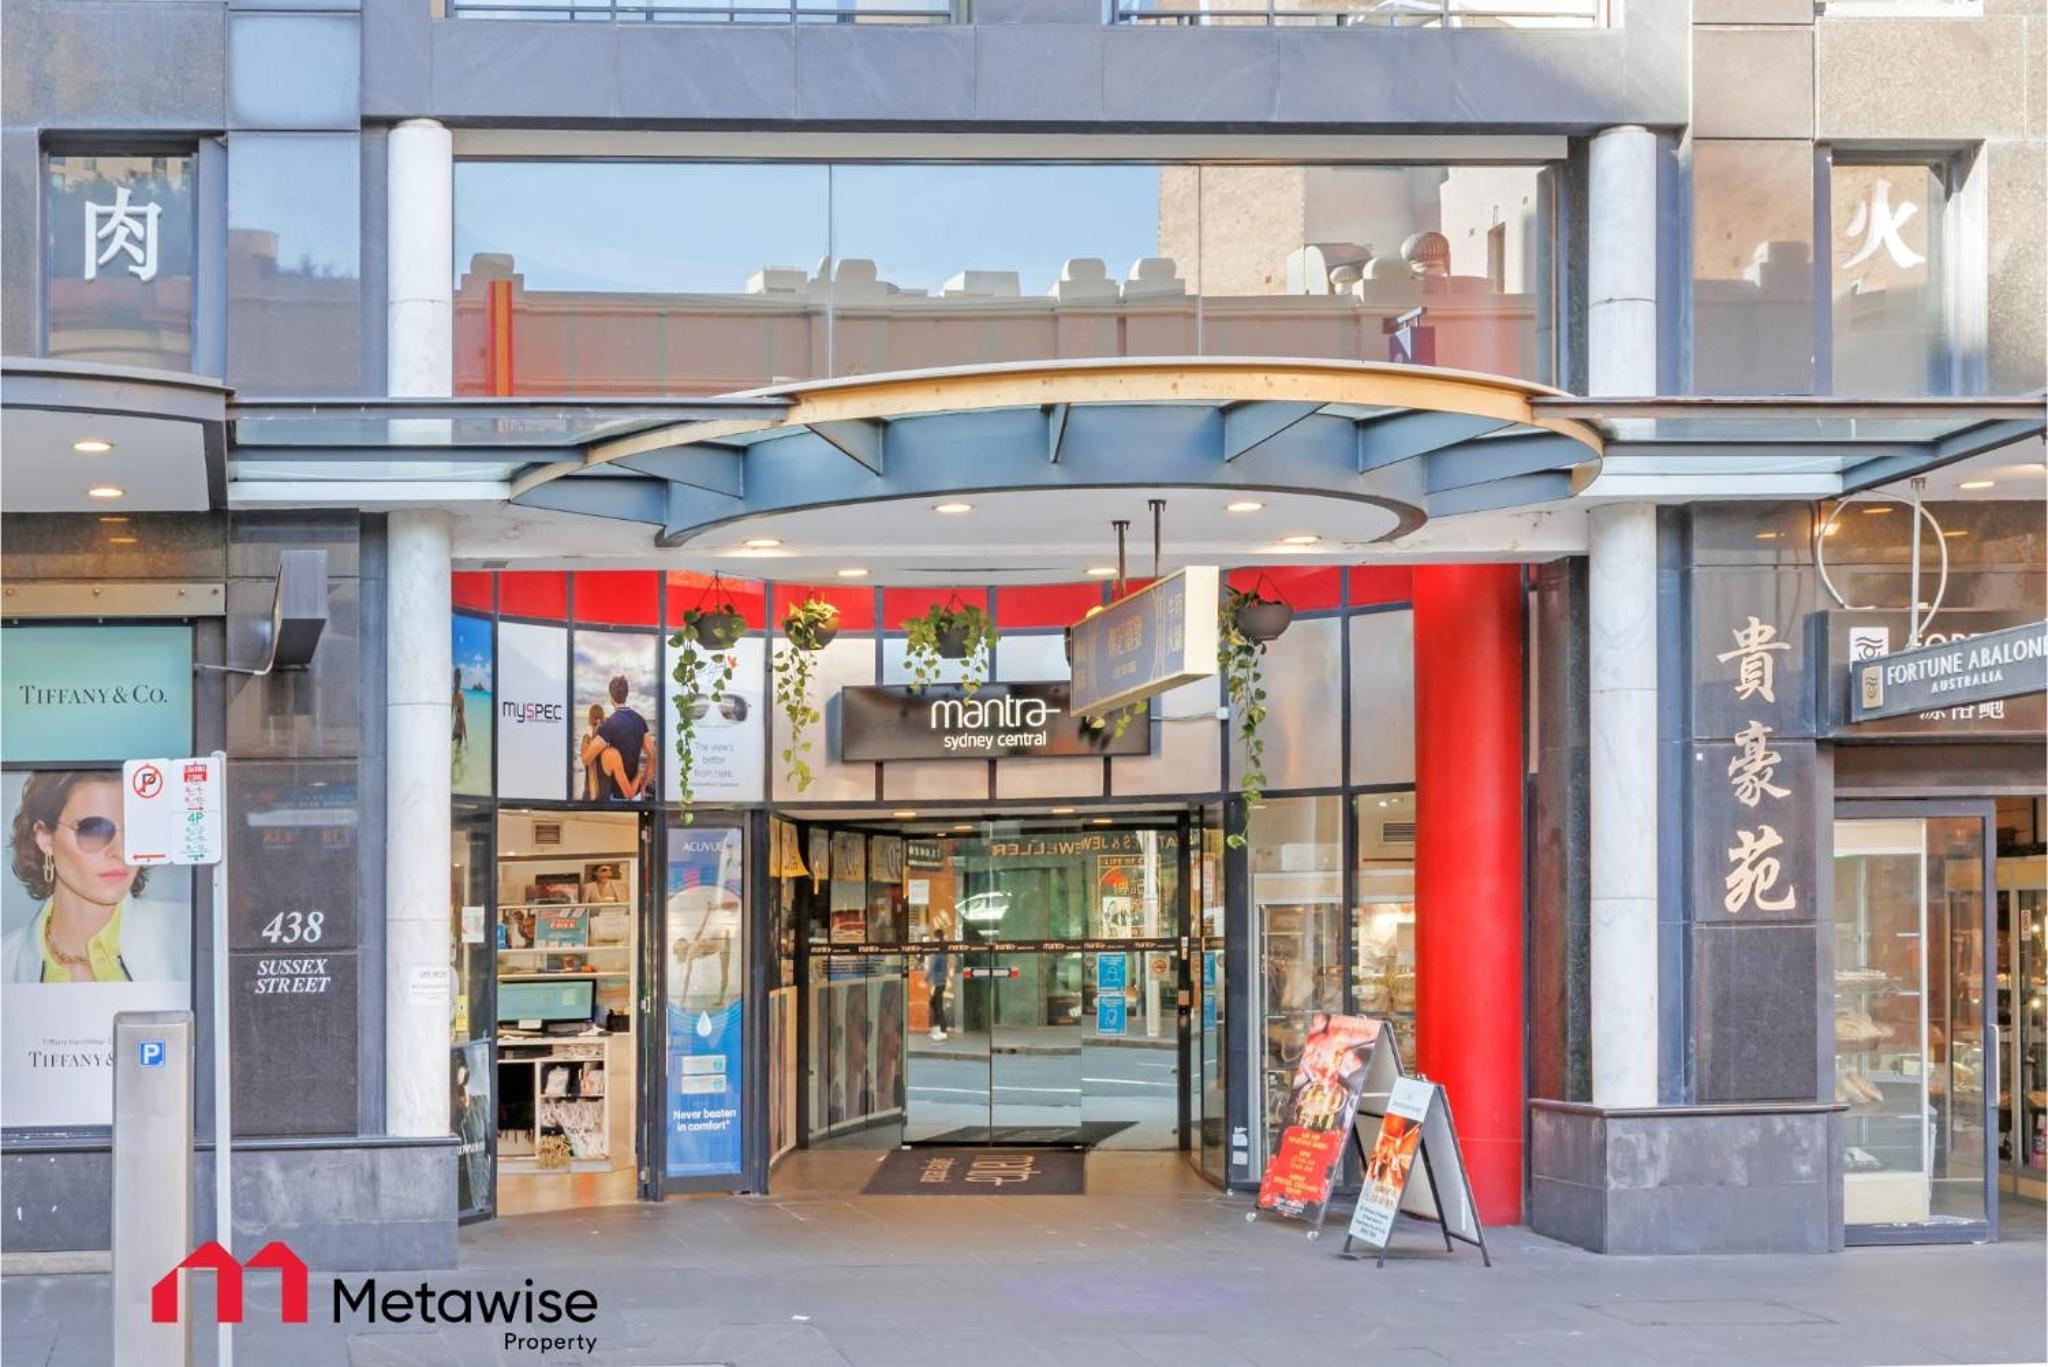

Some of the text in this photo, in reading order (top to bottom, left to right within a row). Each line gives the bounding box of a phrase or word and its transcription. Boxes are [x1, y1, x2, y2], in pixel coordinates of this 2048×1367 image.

[84, 186, 162, 282] 肉
[1842, 180, 1926, 270] 火
[1887, 652, 1963, 686] FORTUNE
[1931, 669, 2003, 694] AUSTRALIA
[19, 684, 109, 705] TIFFANY
[112, 686, 128, 704] &
[930, 694, 1061, 729] mantra
[944, 731, 1047, 750] sydney central
[1717, 616, 1796, 914] 貴豪苑
[261, 911, 324, 943] 438
[257, 959, 328, 976] SUSSEX
[254, 976, 331, 994] STREET
[673, 1110, 701, 1120] Never
[677, 1123, 687, 1131] in
